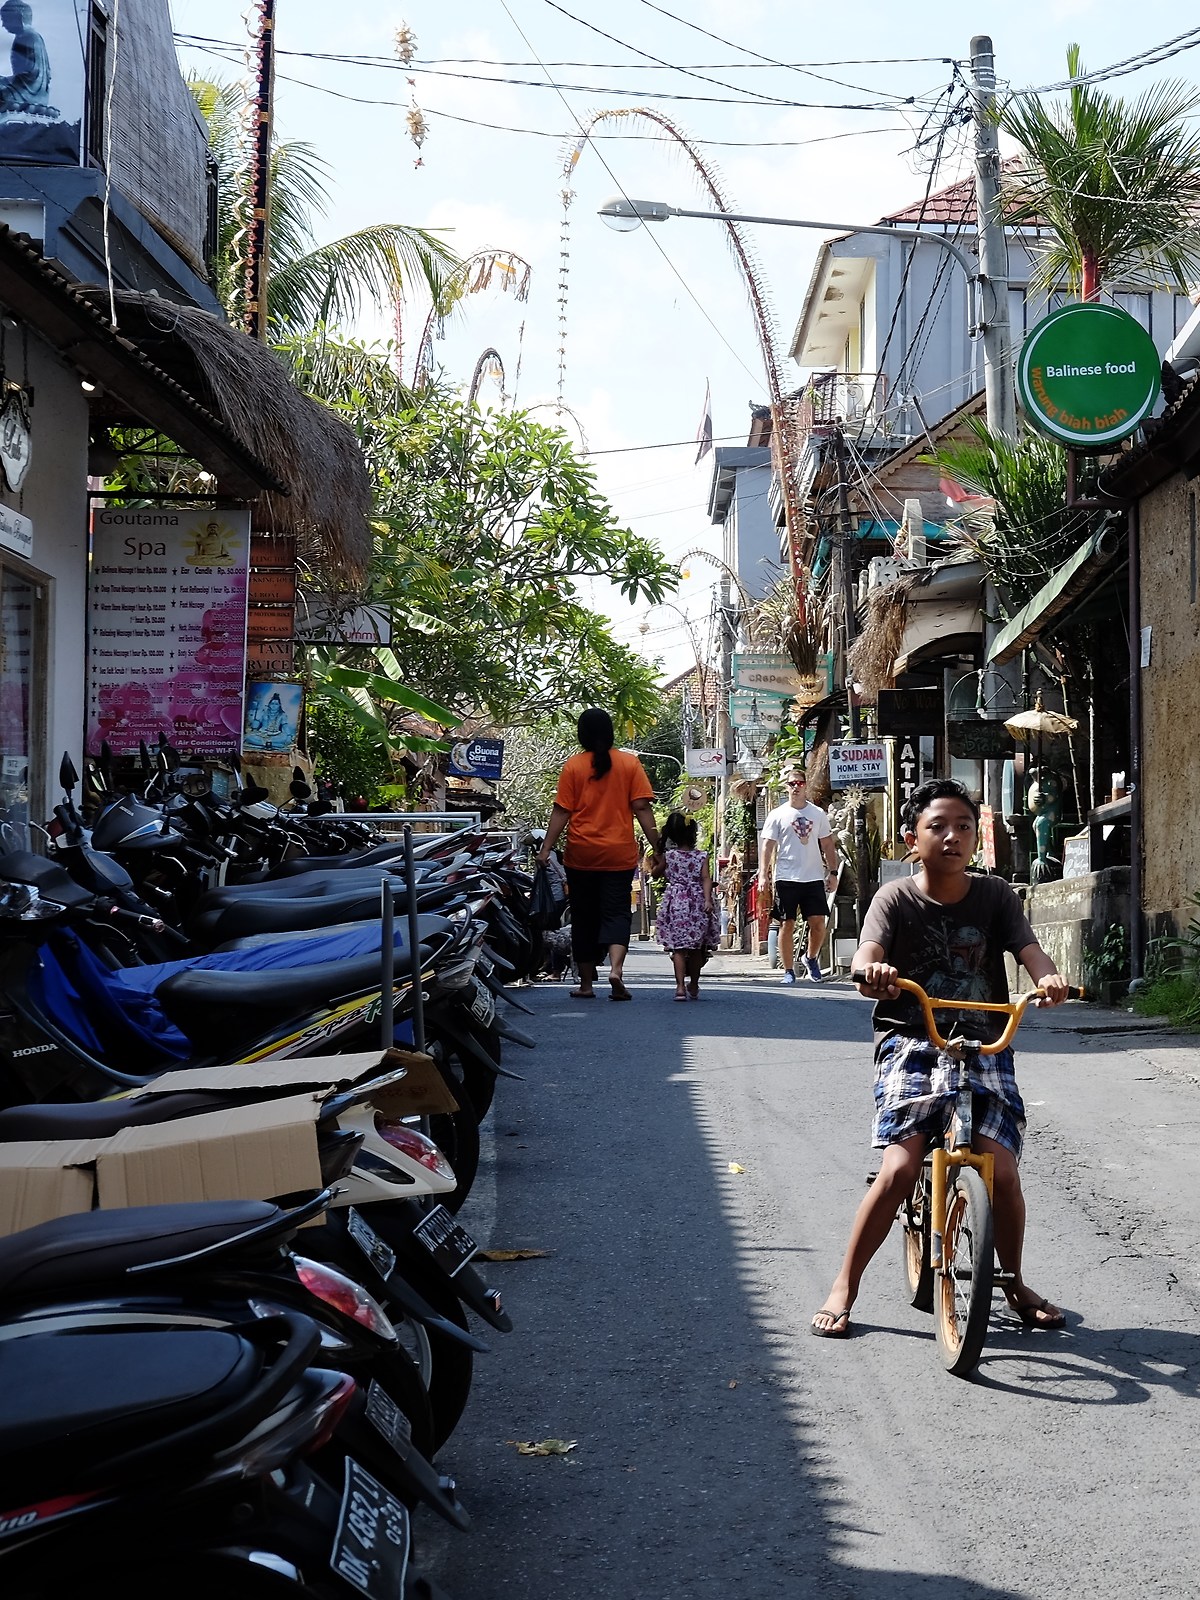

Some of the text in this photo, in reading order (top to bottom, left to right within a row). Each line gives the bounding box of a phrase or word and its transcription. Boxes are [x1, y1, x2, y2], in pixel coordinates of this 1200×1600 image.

[1046, 361, 1136, 377] Balinese food
[1032, 367, 1128, 430] warung biah biah
[100, 511, 179, 526] Goutama
[123, 537, 166, 560] Spa
[258, 644, 289, 654] TAXI
[247, 660, 290, 670] RVICE
[468, 751, 487, 762] Sera
[474, 745, 500, 756] Buona
[841, 749, 883, 762] SUDANA
[837, 763, 881, 773] HOME STAY
[12, 1043, 58, 1058] HONDA
[417, 1227, 438, 1252] DK
[339, 1463, 379, 1588] DK 4852 LT
